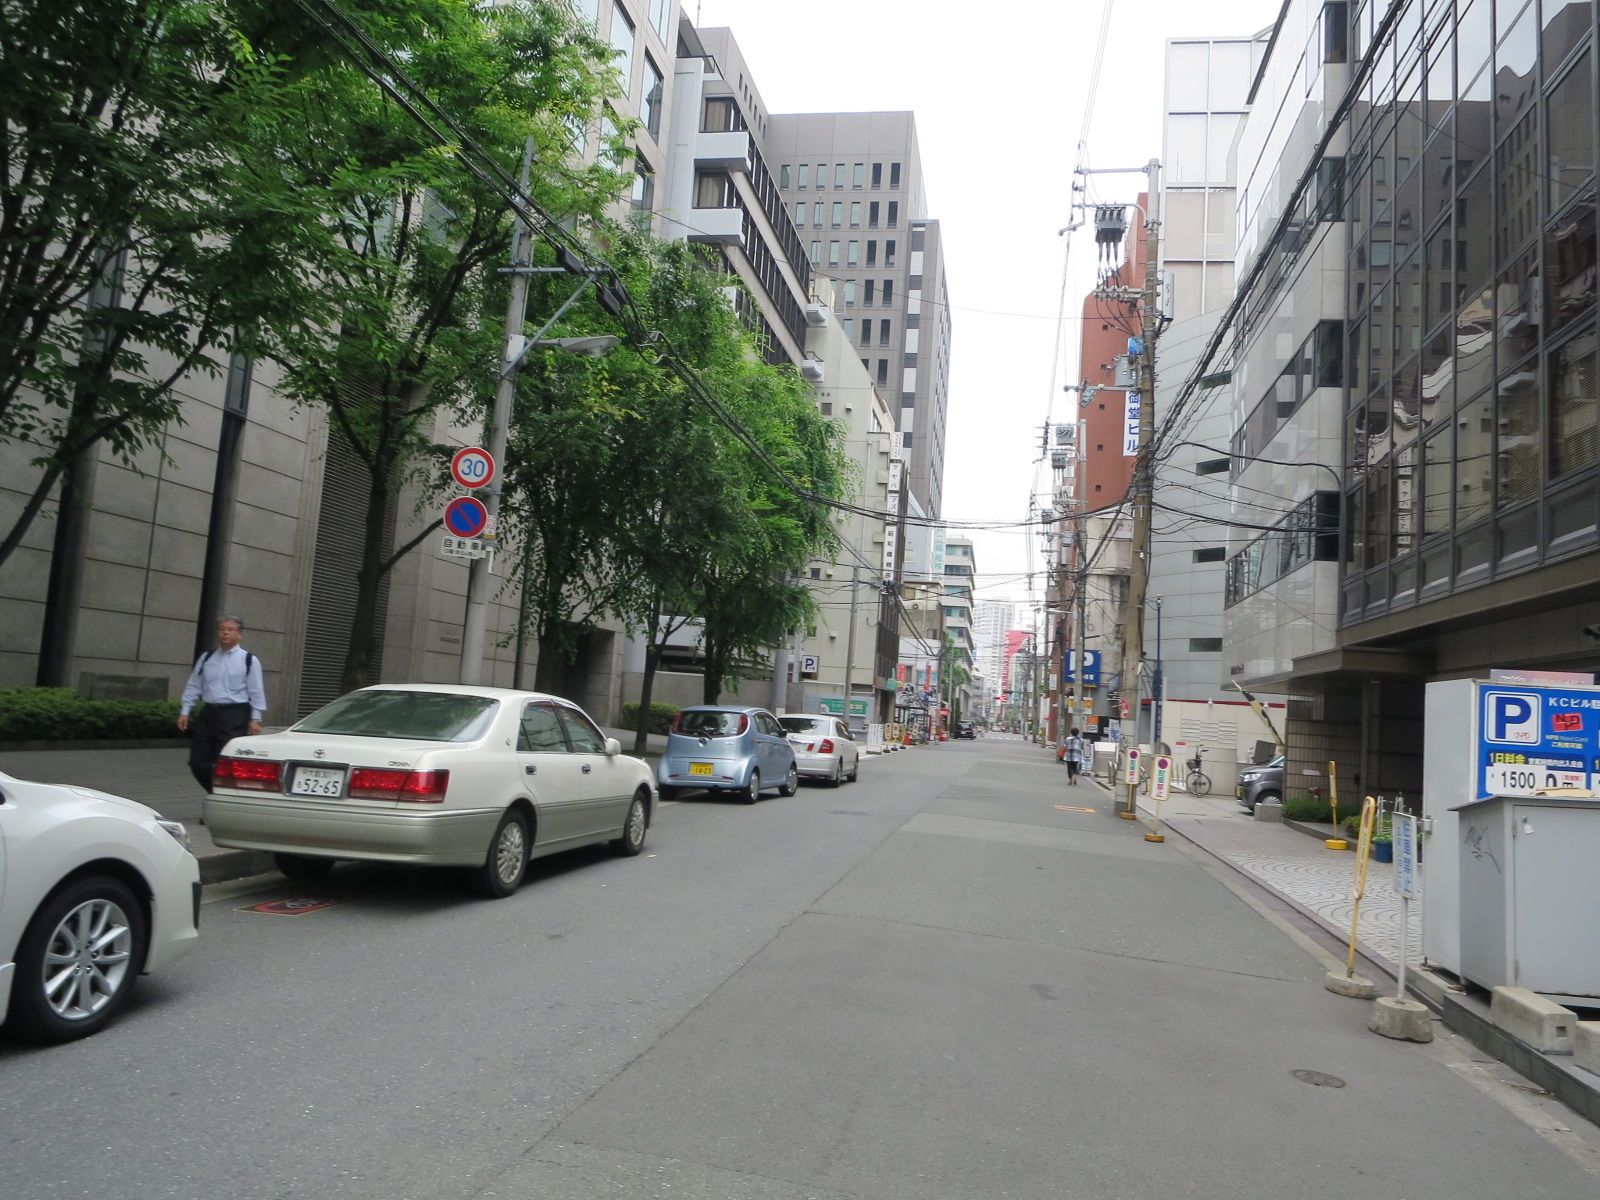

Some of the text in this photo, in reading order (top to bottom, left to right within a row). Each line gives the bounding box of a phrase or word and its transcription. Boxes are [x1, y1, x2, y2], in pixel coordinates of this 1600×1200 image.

[461, 458, 485, 477] 30
[443, 538, 479, 550] 自動車
[805, 658, 814, 670] P
[1494, 696, 1532, 739] P
[303, 778, 340, 795] 52-65
[1501, 771, 1536, 789] 1500
